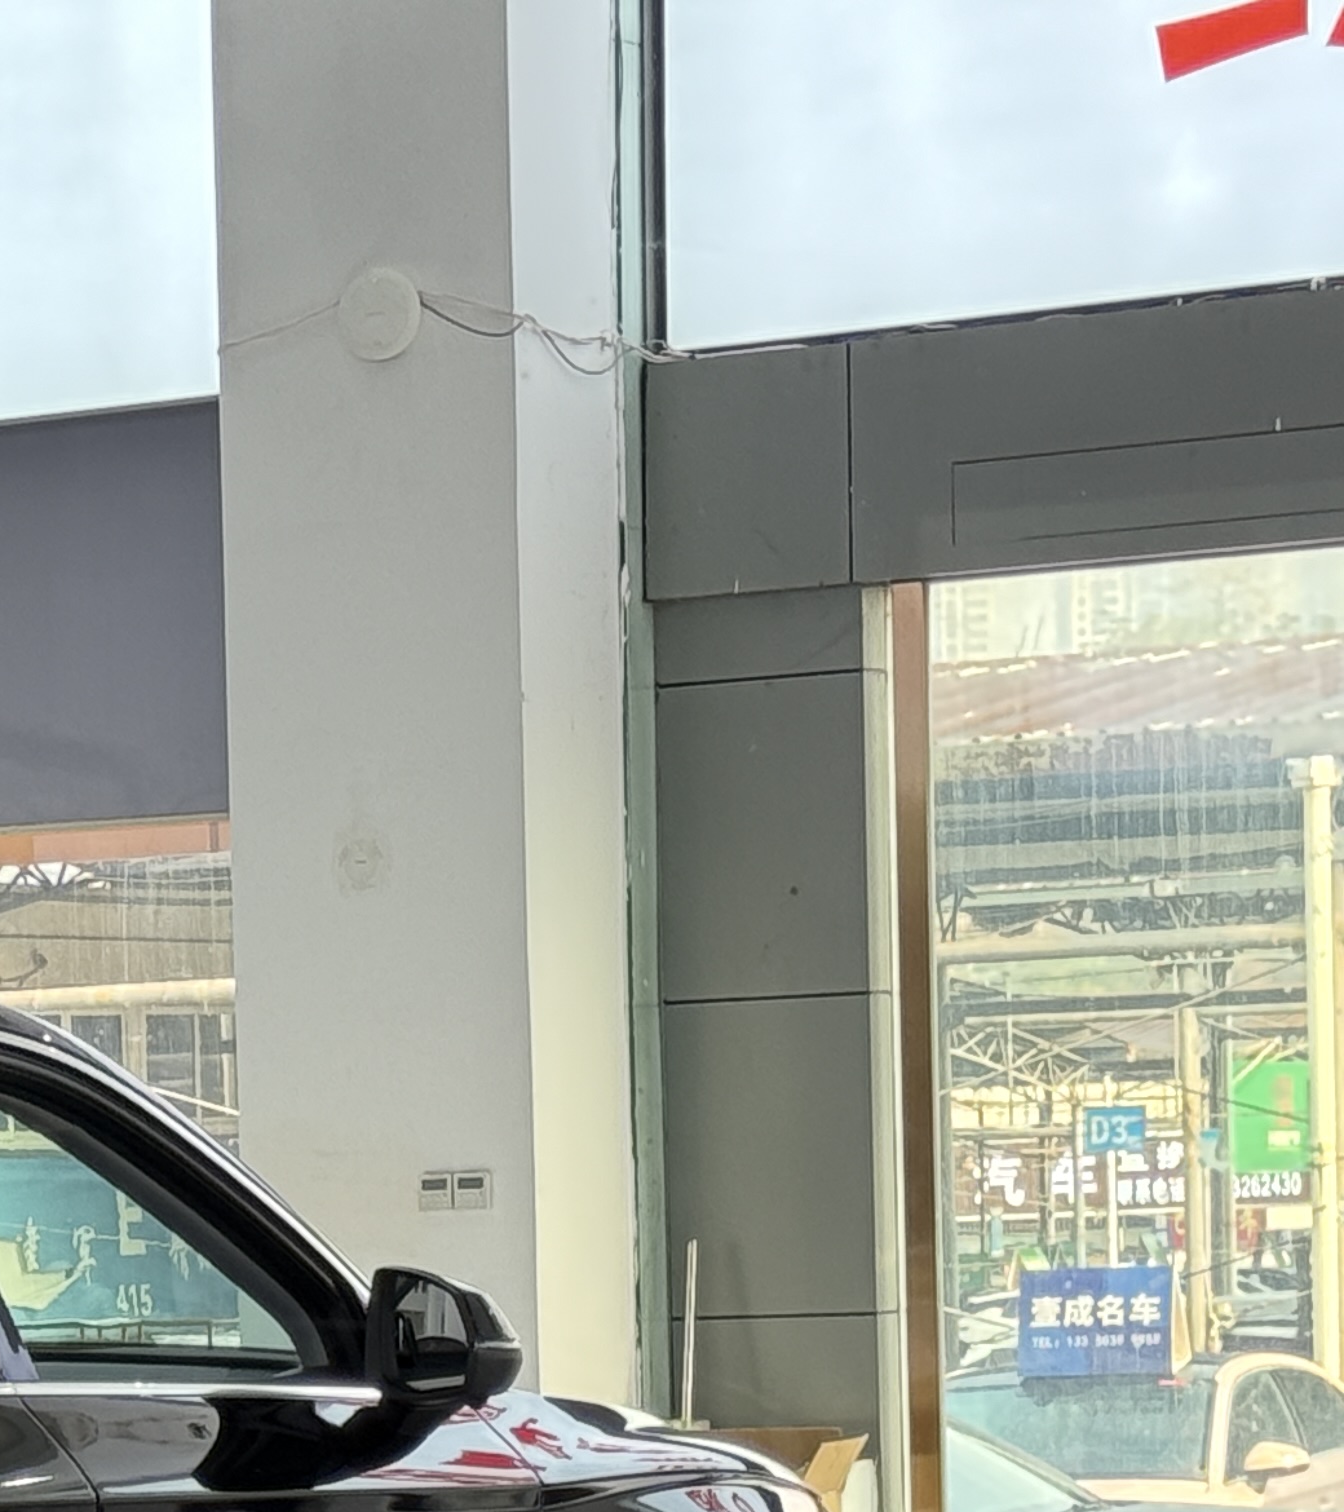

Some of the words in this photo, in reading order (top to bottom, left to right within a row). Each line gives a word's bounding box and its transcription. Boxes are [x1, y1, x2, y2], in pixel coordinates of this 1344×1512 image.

[1091, 1115, 1129, 1145] D3
[1029, 1293, 1162, 1328] 壹成名车
